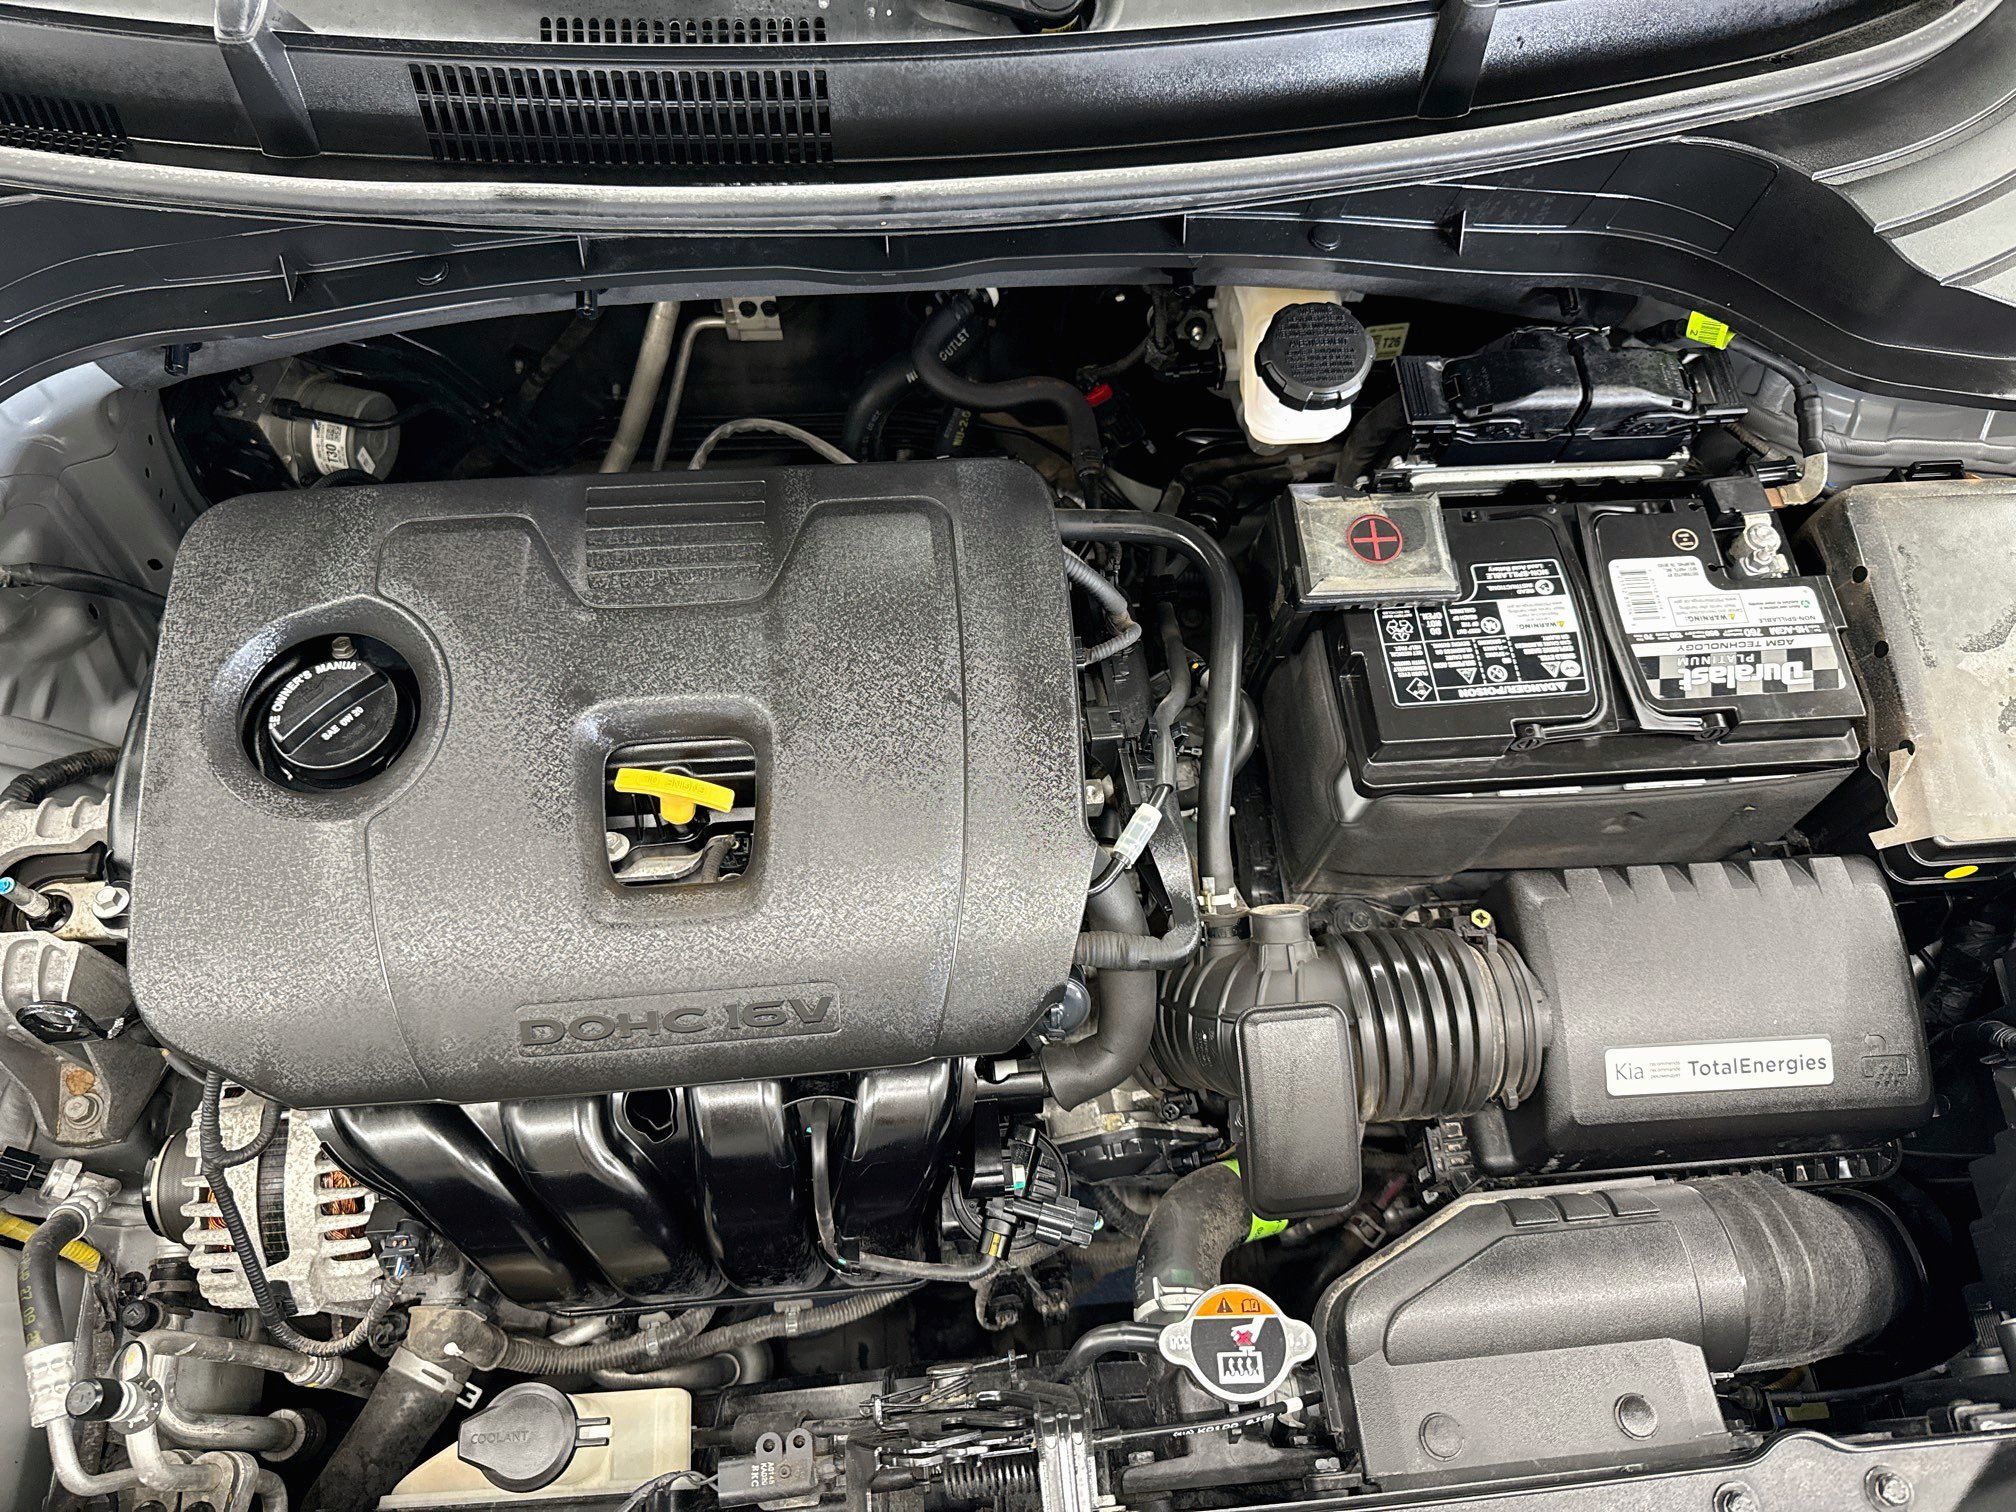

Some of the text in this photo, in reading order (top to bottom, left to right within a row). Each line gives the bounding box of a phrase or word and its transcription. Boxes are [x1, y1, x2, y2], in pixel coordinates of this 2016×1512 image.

[939, 328, 970, 361] OUTLET
[1383, 336, 1401, 348] T26
[325, 442, 339, 464] T30
[1485, 569, 1550, 579] NON-SPILLABLE
[1758, 615, 1816, 623] NON-SPILLABLE
[1743, 628, 1763, 637] 760
[1677, 641, 1761, 651] TECHNOLOGY
[1677, 653, 1754, 666] PLATINUM
[1678, 661, 1813, 691] Duralast
[271, 670, 312, 712] OWNER'S
[315, 661, 362, 675] MANUA
[1458, 682, 1558, 698] DANGER/POISON
[320, 724, 340, 741] SAE
[351, 706, 365, 718] 20
[667, 779, 705, 794] ENGINE
[519, 996, 835, 1047] DOHC 16V
[1615, 1054, 1827, 1081] Kia TotalEnergies
[470, 1430, 530, 1445] COOLANT
